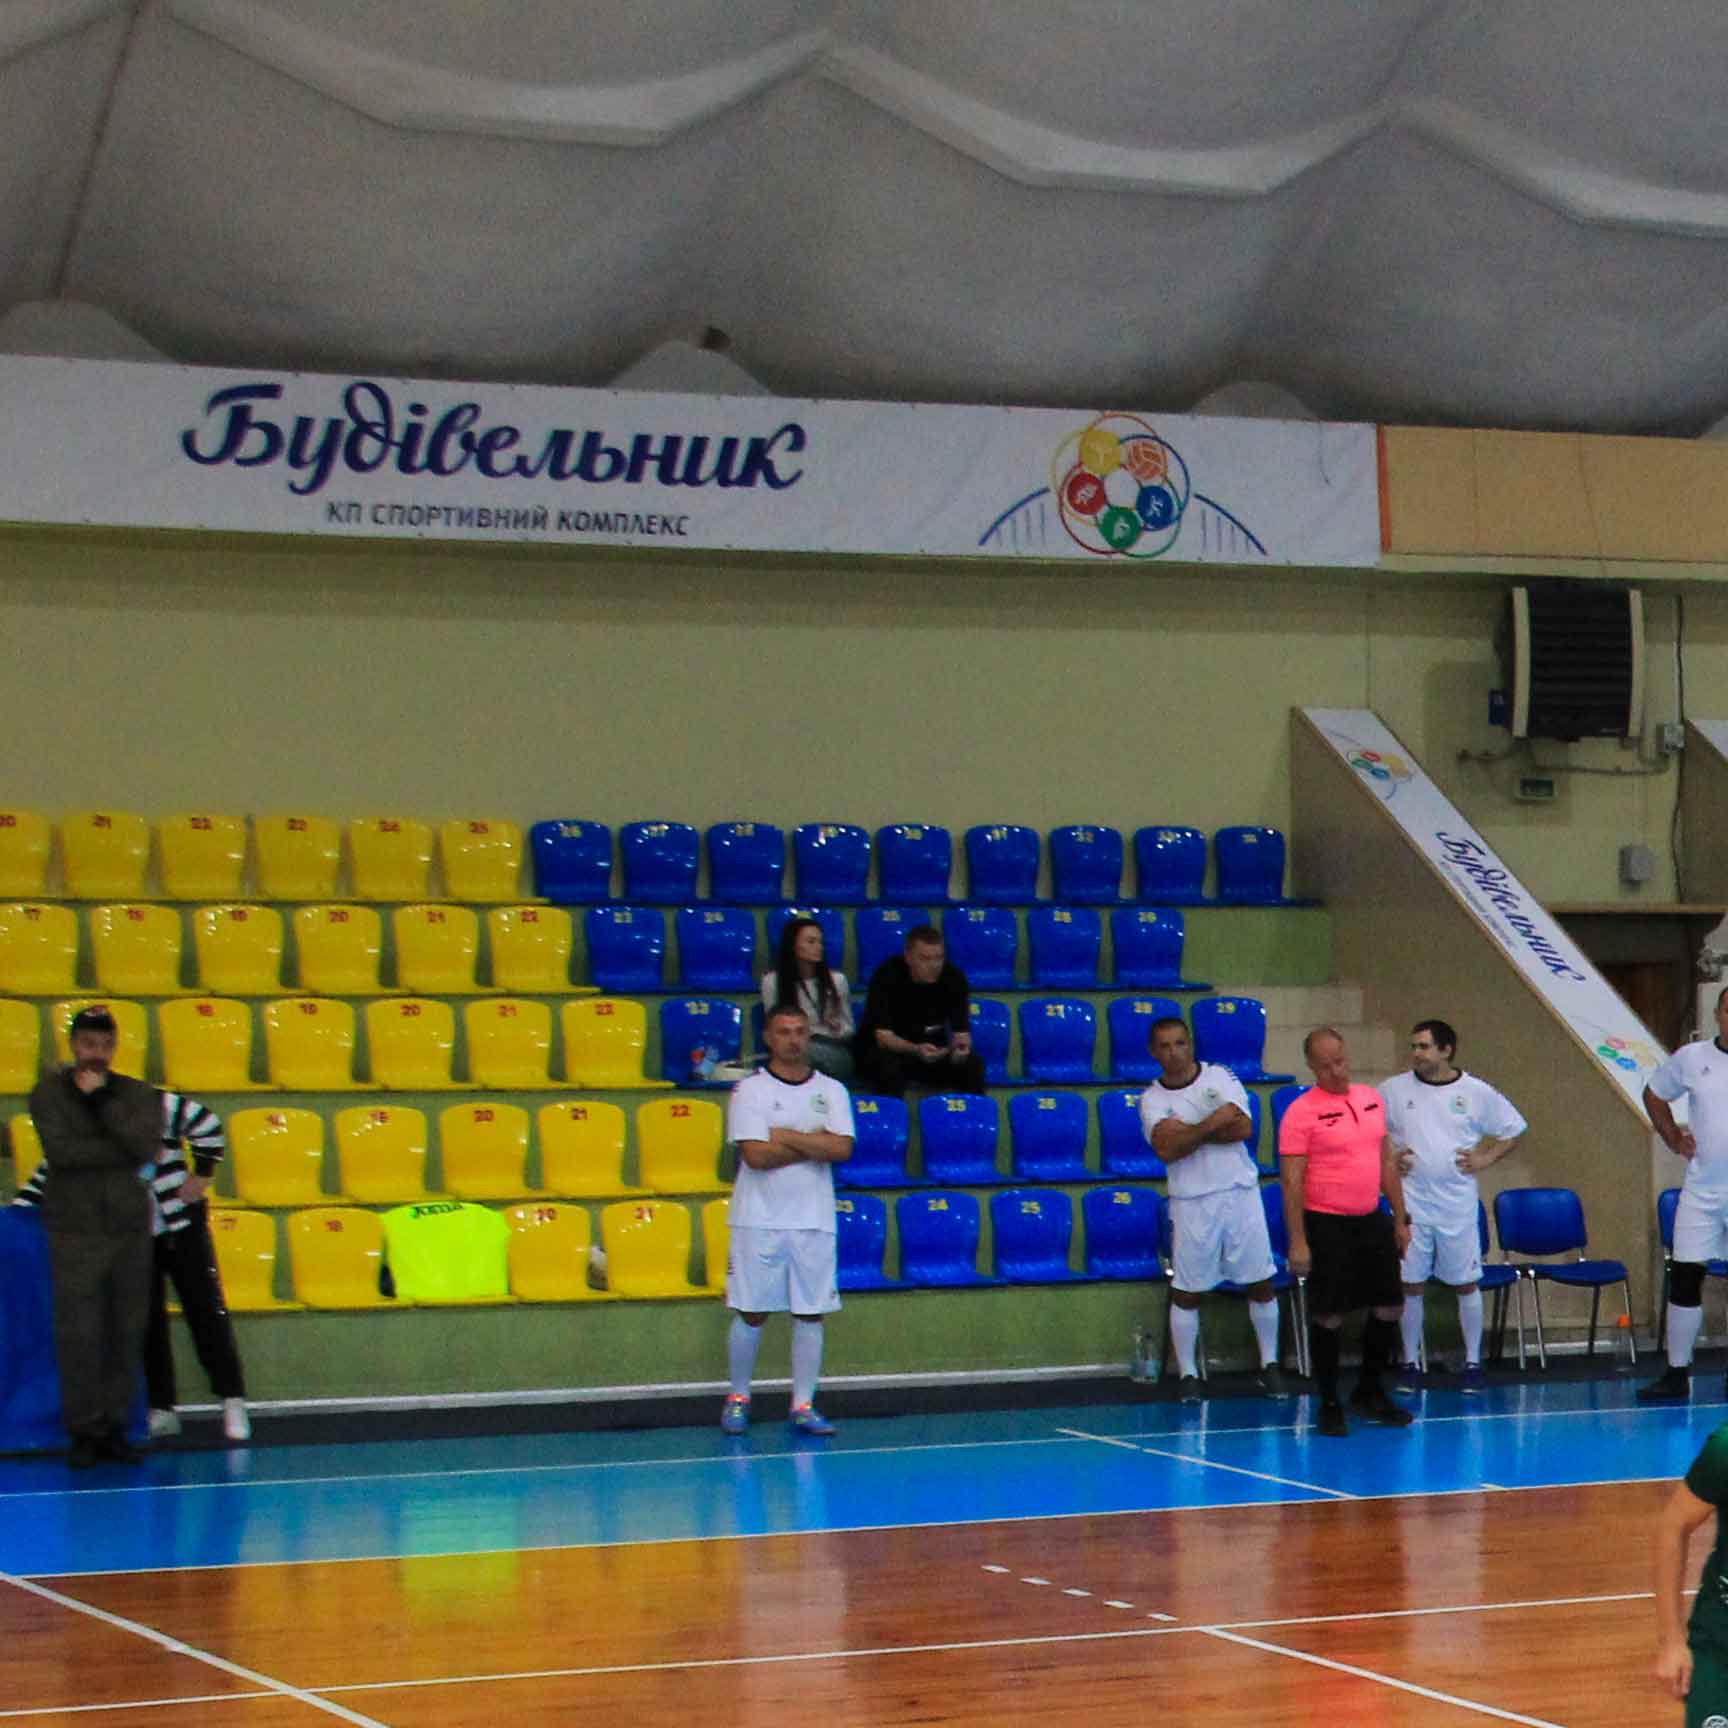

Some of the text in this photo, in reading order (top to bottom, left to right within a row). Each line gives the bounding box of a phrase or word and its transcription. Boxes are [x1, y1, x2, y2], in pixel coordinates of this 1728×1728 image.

[181, 380, 807, 496] Будівельник
[325, 502, 691, 537] КП СПОРТИВНИЙ КОМПЛЕКС
[1435, 831, 1586, 982] Будівельник
[671, 1105, 691, 1117] 22
